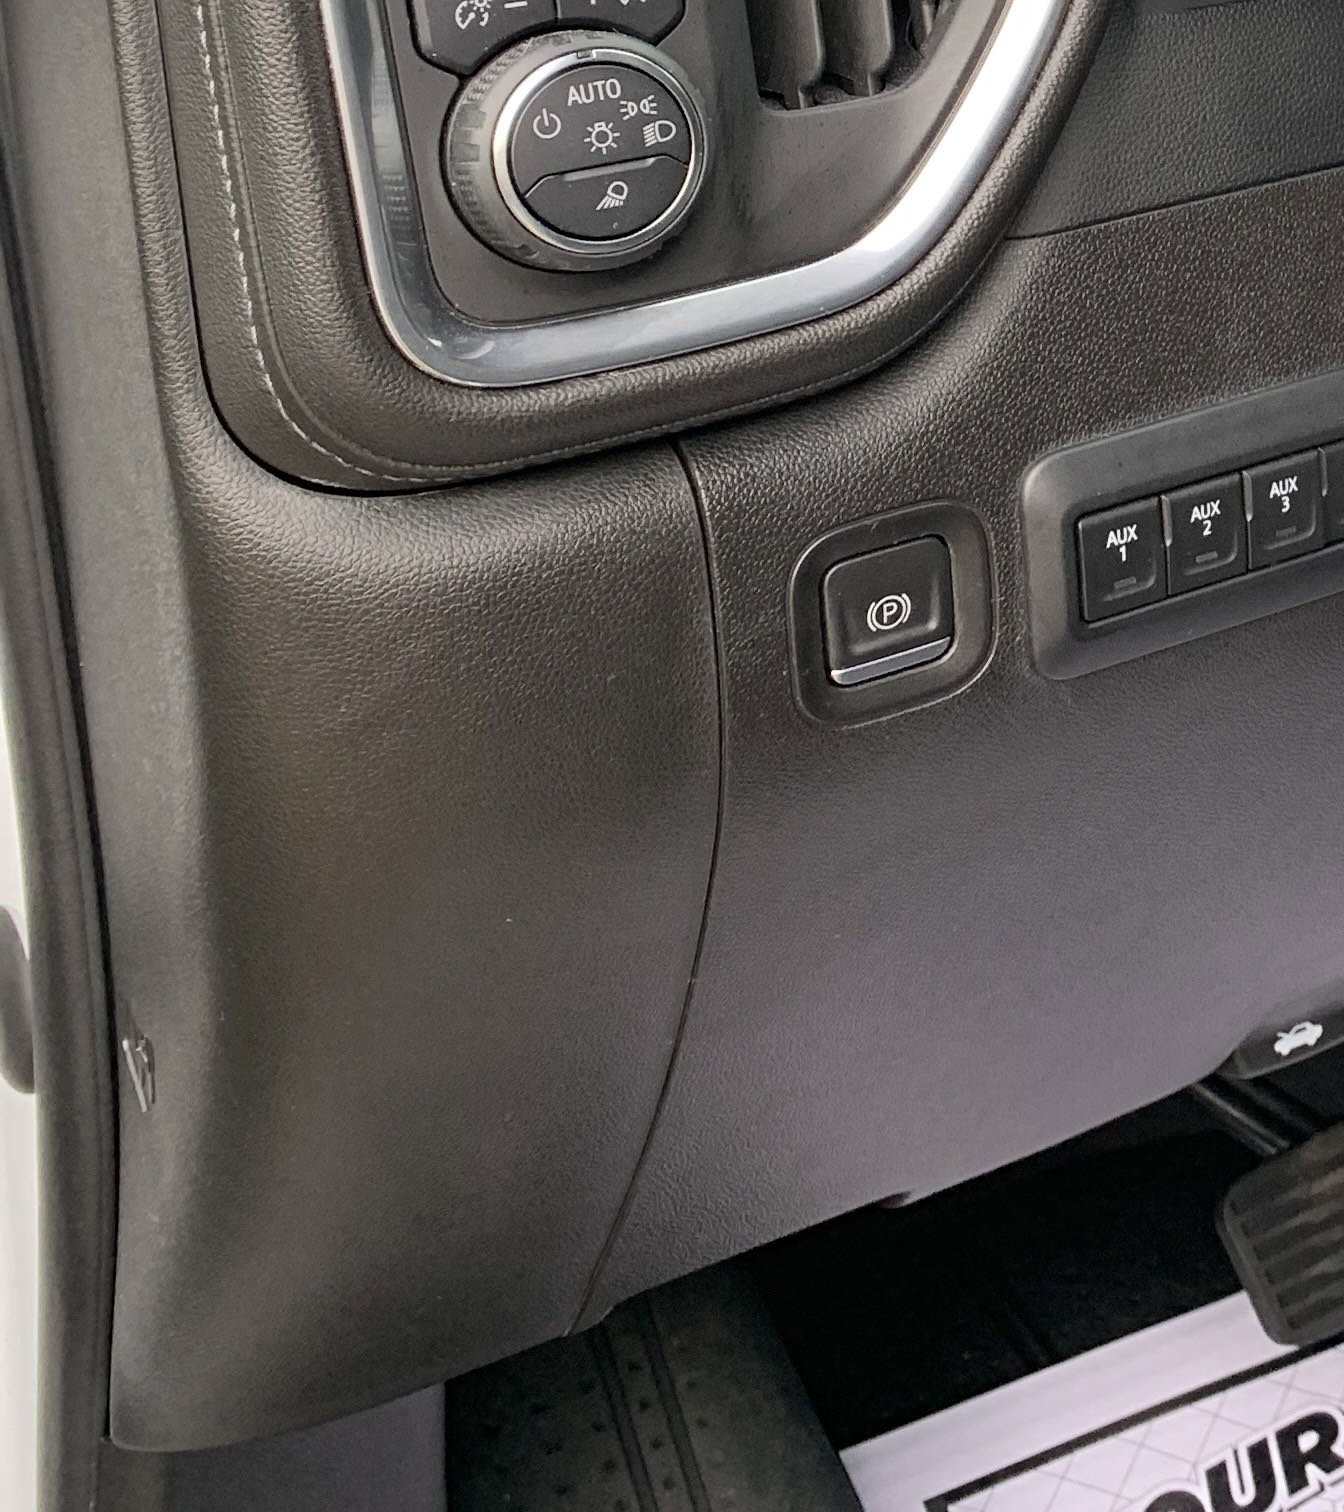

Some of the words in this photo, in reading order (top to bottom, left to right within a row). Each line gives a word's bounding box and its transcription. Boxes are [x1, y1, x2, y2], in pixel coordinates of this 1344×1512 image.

[567, 78, 621, 106] AUTO
[1269, 476, 1298, 499] AUX
[1190, 500, 1221, 523] AUX
[1281, 496, 1290, 513] 3
[1106, 524, 1138, 549] AUX
[1202, 521, 1212, 536] 2
[1118, 546, 1126, 562] 1
